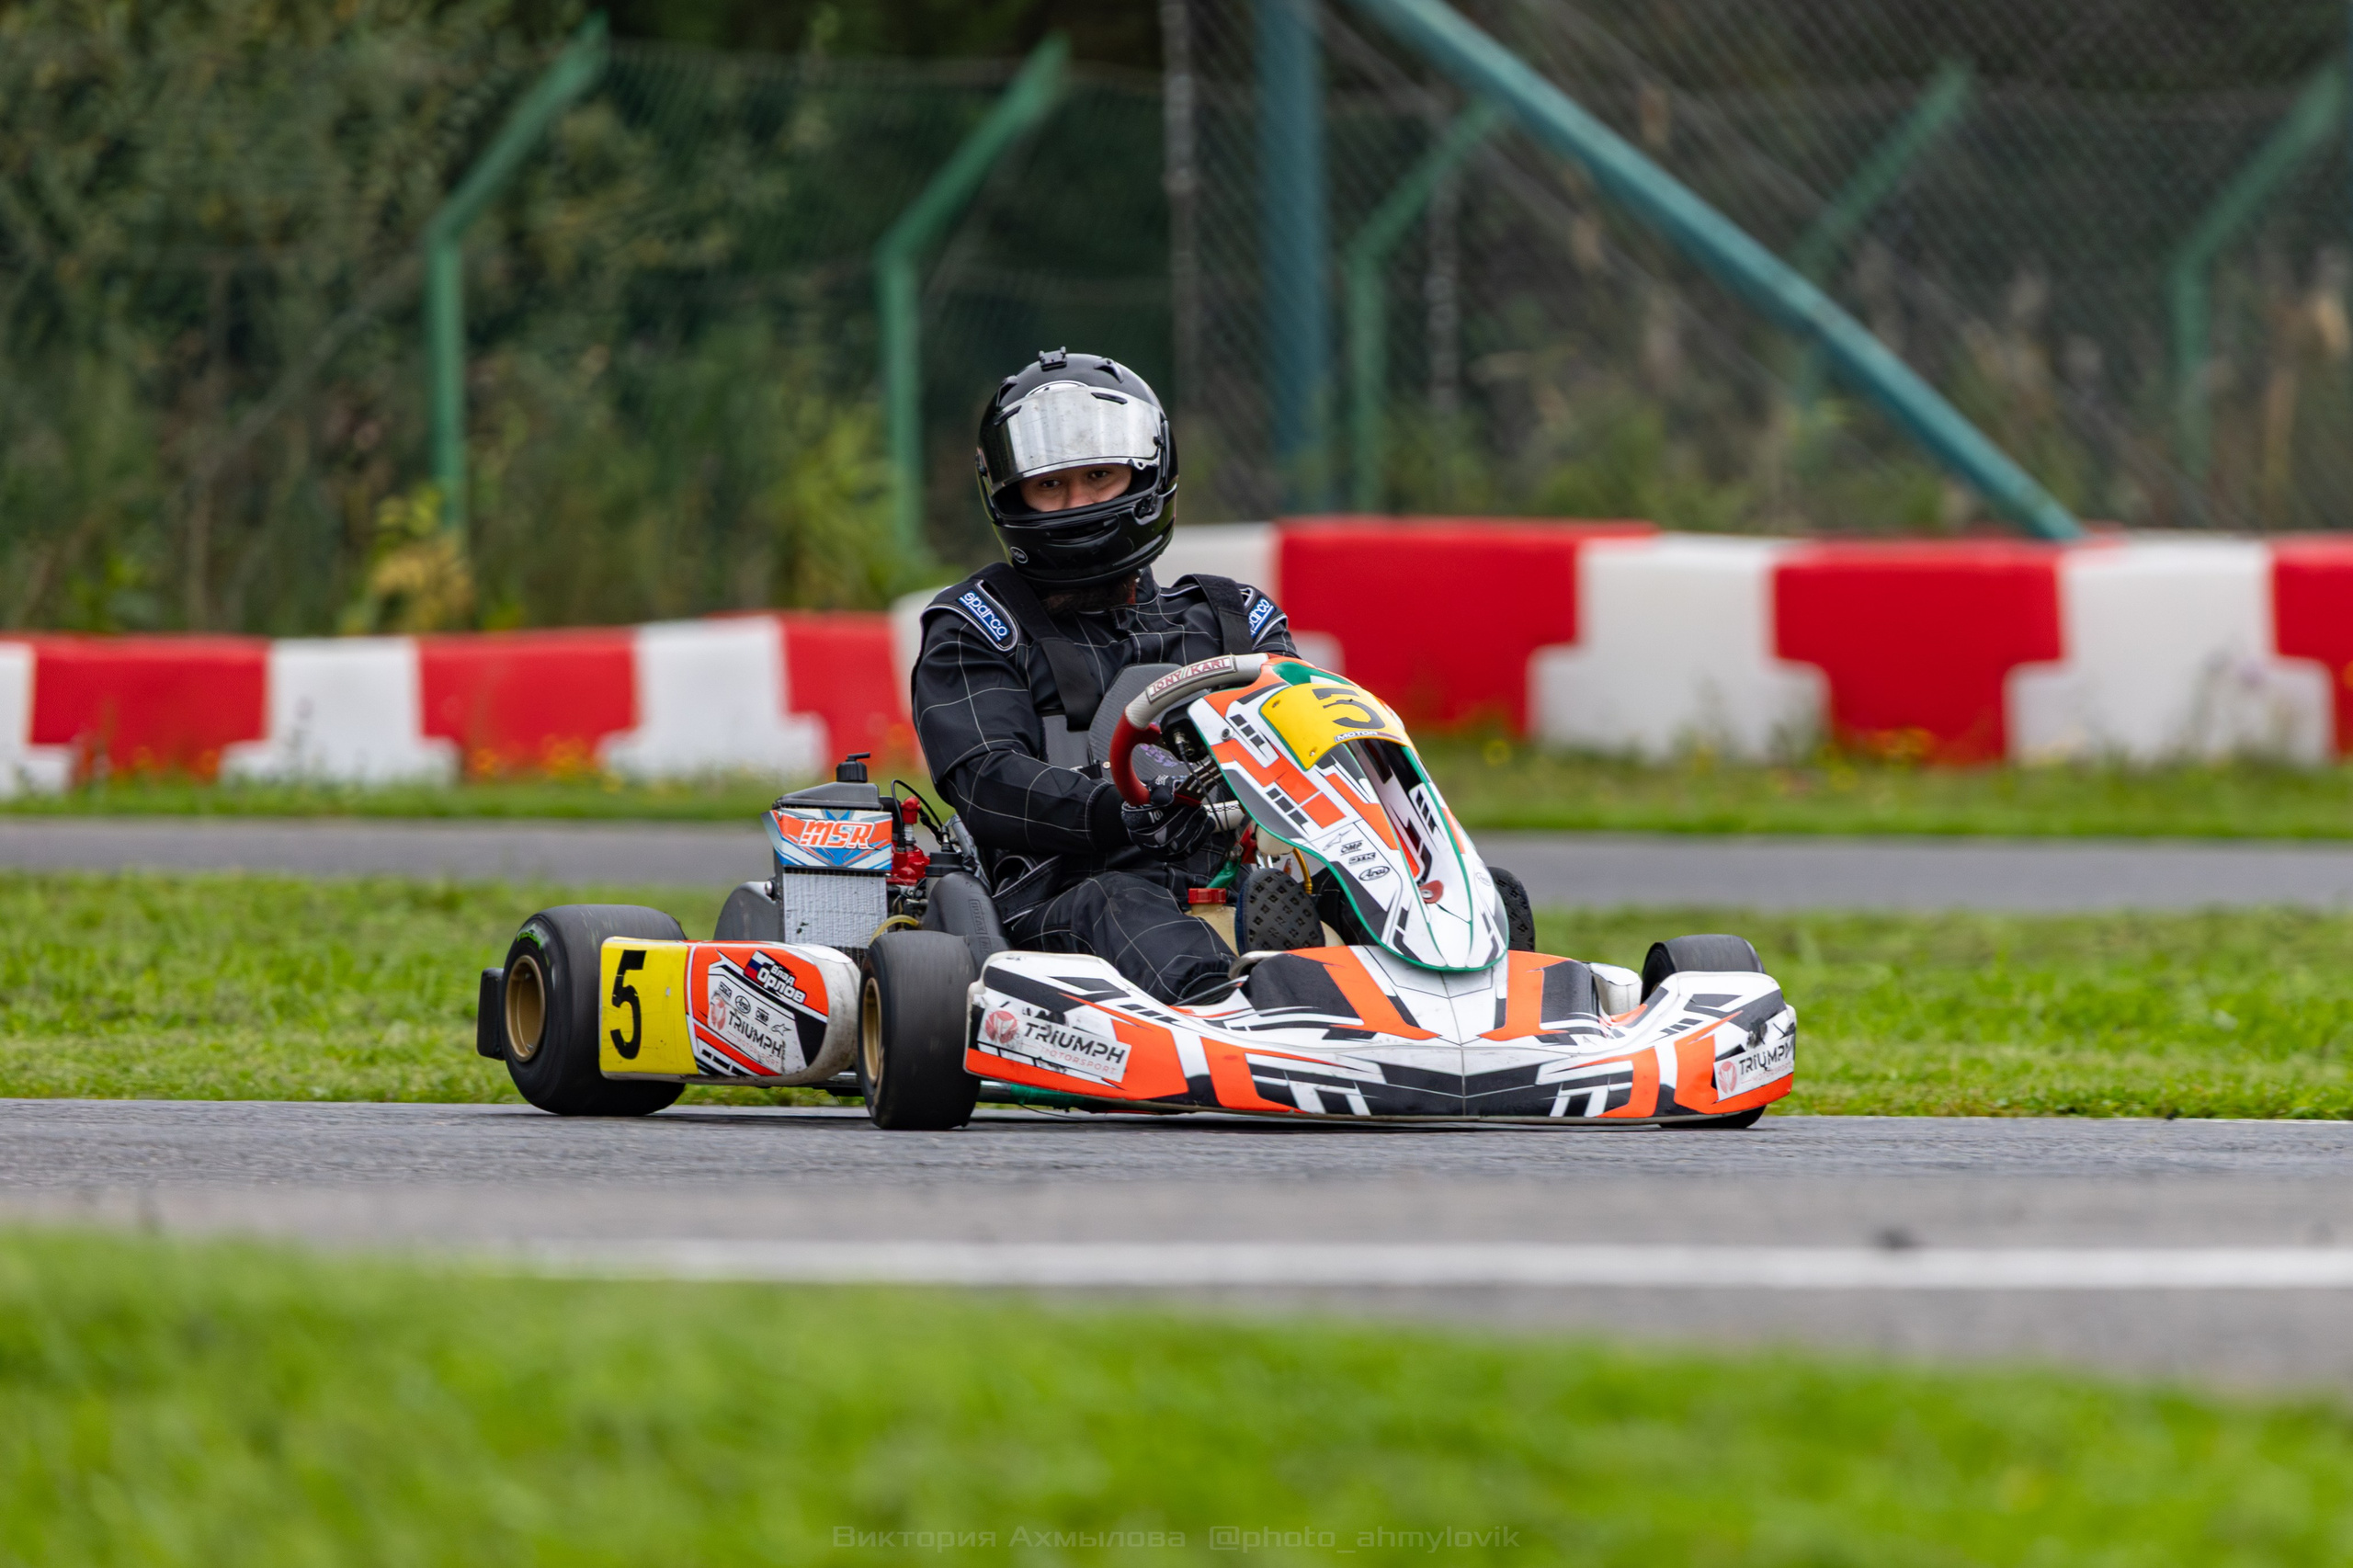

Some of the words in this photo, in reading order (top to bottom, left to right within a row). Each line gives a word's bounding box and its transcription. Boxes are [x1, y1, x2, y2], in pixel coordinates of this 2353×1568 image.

[962, 592, 1008, 637] sparco
[1249, 598, 1270, 634] arco
[1312, 687, 1386, 730] 5
[798, 819, 876, 849] MSR
[610, 949, 647, 1060] 5
[729, 1011, 783, 1058] TRIUMPH
[1024, 1022, 1126, 1064] TRIUMPH
[1040, 1046, 1118, 1074] MOTORSPORT
